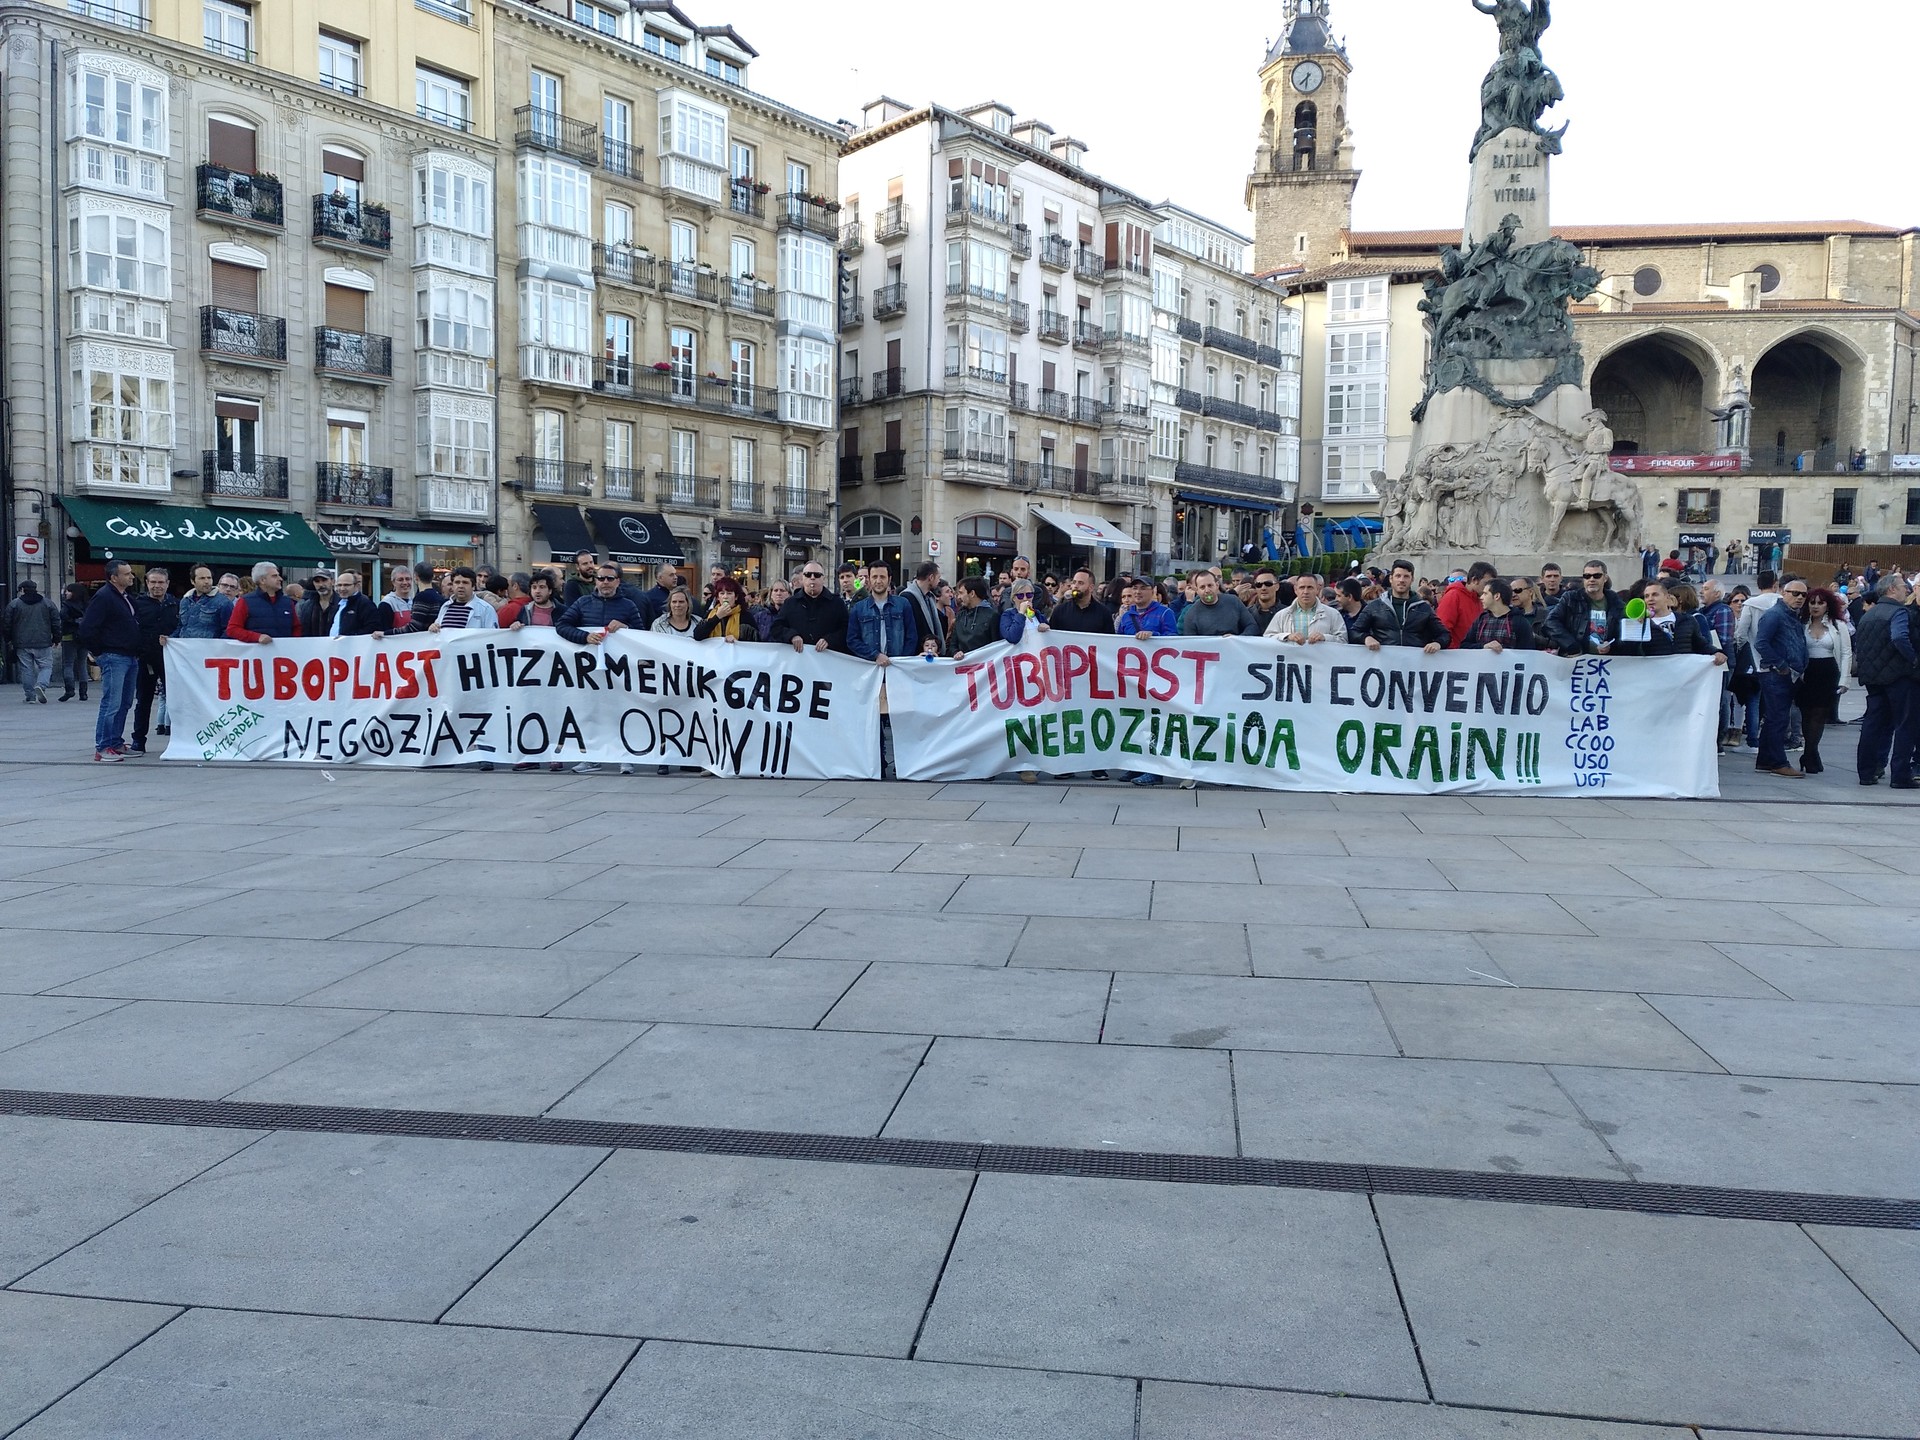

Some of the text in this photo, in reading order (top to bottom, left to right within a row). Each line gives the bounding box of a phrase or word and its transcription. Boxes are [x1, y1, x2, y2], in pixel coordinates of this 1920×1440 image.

[1504, 138, 1528, 148] A LA
[1493, 153, 1540, 169] BATALLA
[1494, 187, 1536, 202] VITORIA
[106, 516, 174, 542] Café
[1751, 530, 1777, 538] ROMA
[617, 555, 638, 563] COMIDA
[1572, 659, 1612, 676] ESK
[204, 650, 441, 700] TUBOPLAST
[723, 670, 832, 720] GABE
[955, 645, 1220, 711] TUBOPLAST
[1571, 677, 1609, 694] ELA
[1570, 696, 1612, 713] CGT
[196, 704, 249, 746] ENPRESA
[1571, 715, 1609, 732] LAB
[1565, 734, 1615, 751] CCOO
[1574, 753, 1609, 769] USO
[1574, 773, 1612, 787] UGT
